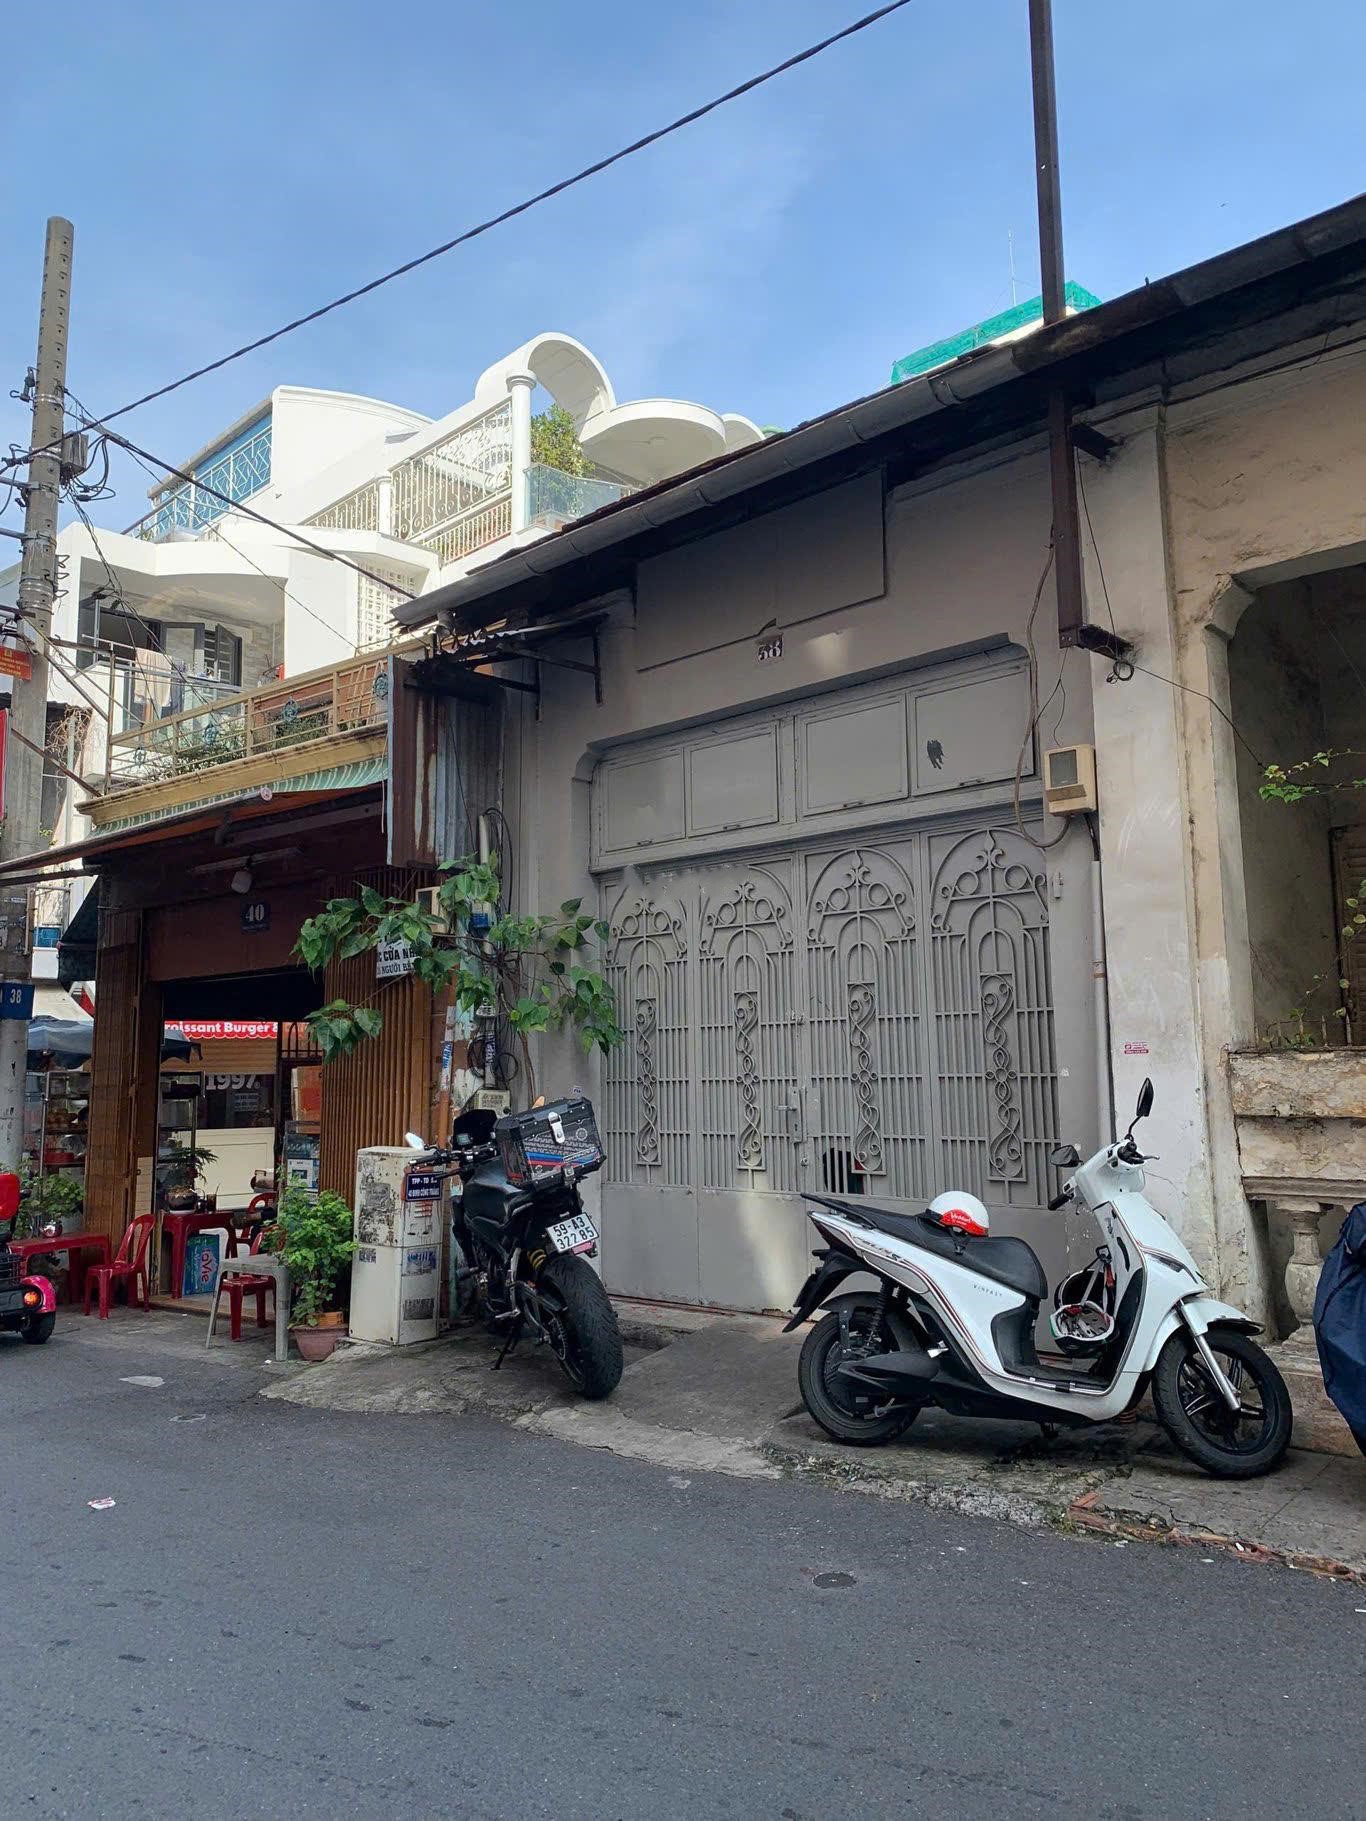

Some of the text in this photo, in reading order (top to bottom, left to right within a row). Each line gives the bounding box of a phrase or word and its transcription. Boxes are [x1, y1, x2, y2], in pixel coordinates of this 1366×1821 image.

[245, 904, 265, 921] 40
[10, 988, 22, 1004] 38
[165, 1021, 221, 1033] roissant
[223, 1021, 270, 1035] Burger
[553, 1216, 586, 1237] 59-A3
